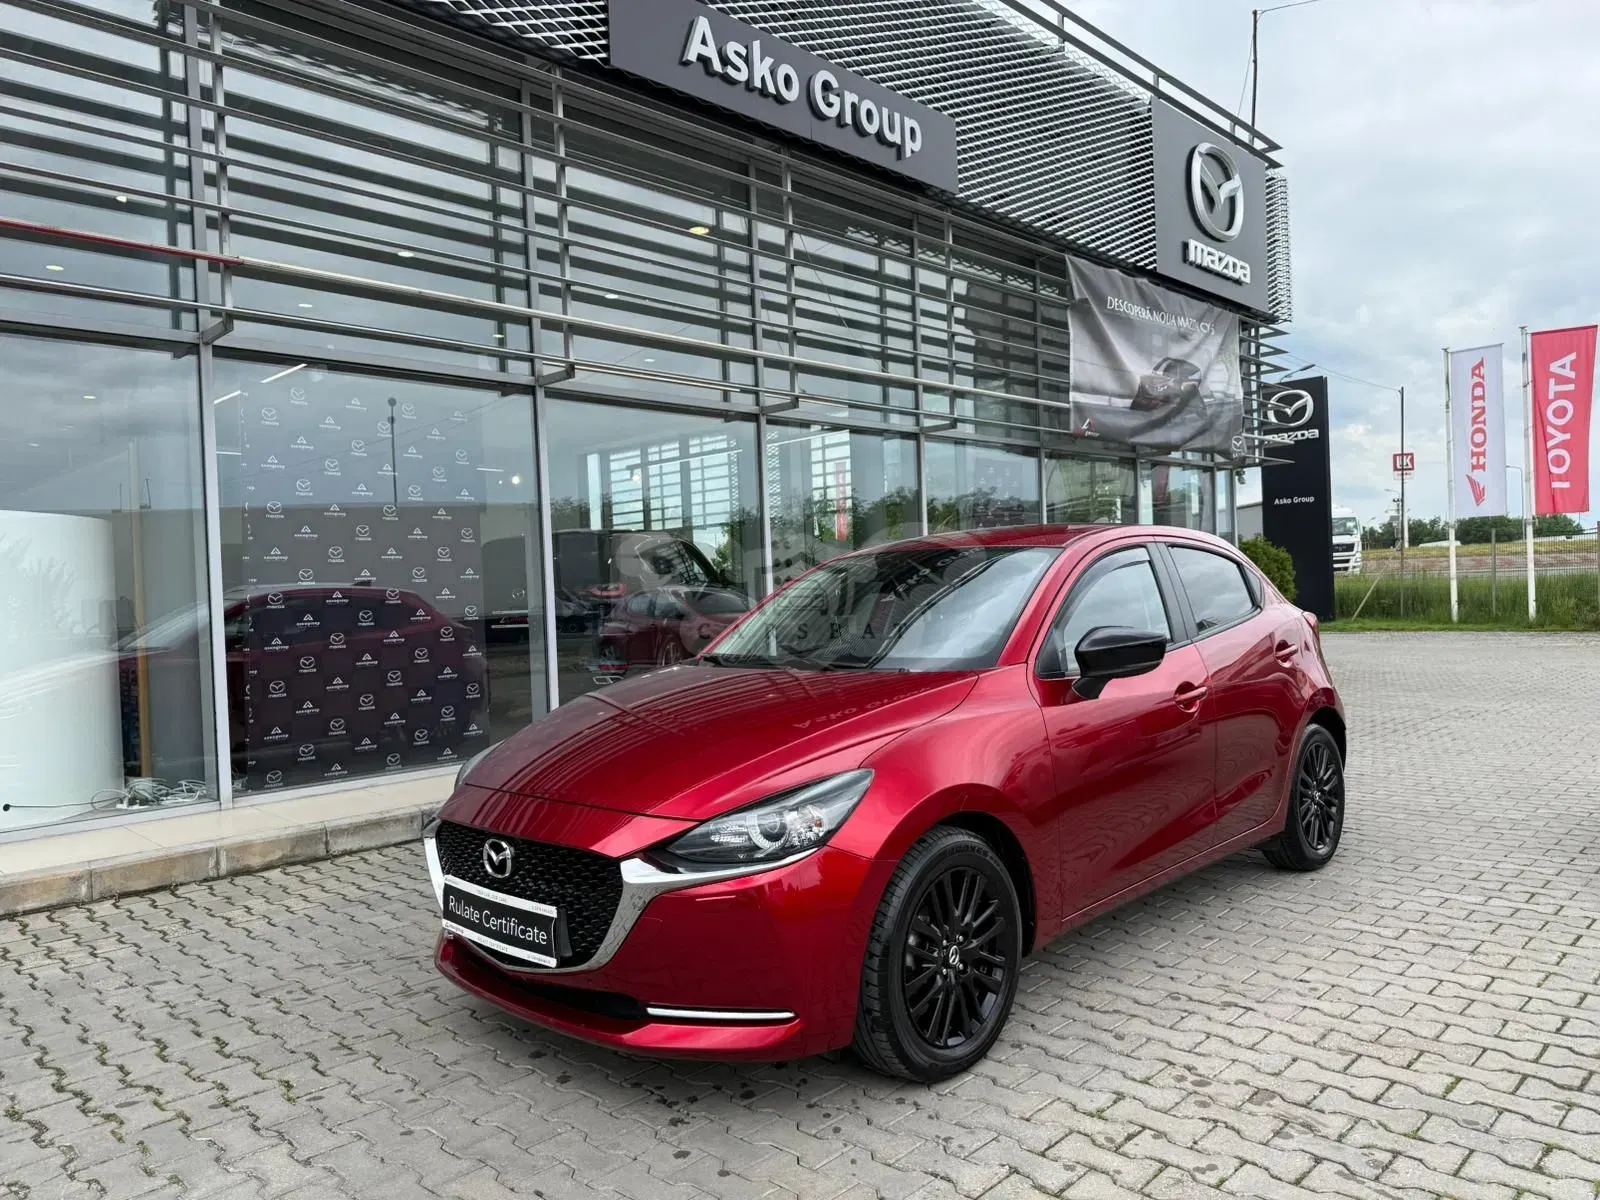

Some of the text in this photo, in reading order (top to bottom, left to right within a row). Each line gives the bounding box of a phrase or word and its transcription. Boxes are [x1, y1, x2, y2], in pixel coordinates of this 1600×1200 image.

[681, 15, 923, 159] Asko Group
[1106, 296, 1152, 321] DESCOPERĂ
[1470, 357, 1487, 472] HONDA
[1293, 496, 1315, 504] Group
[449, 895, 480, 923] Rulate
[482, 910, 548, 945] Certificate
